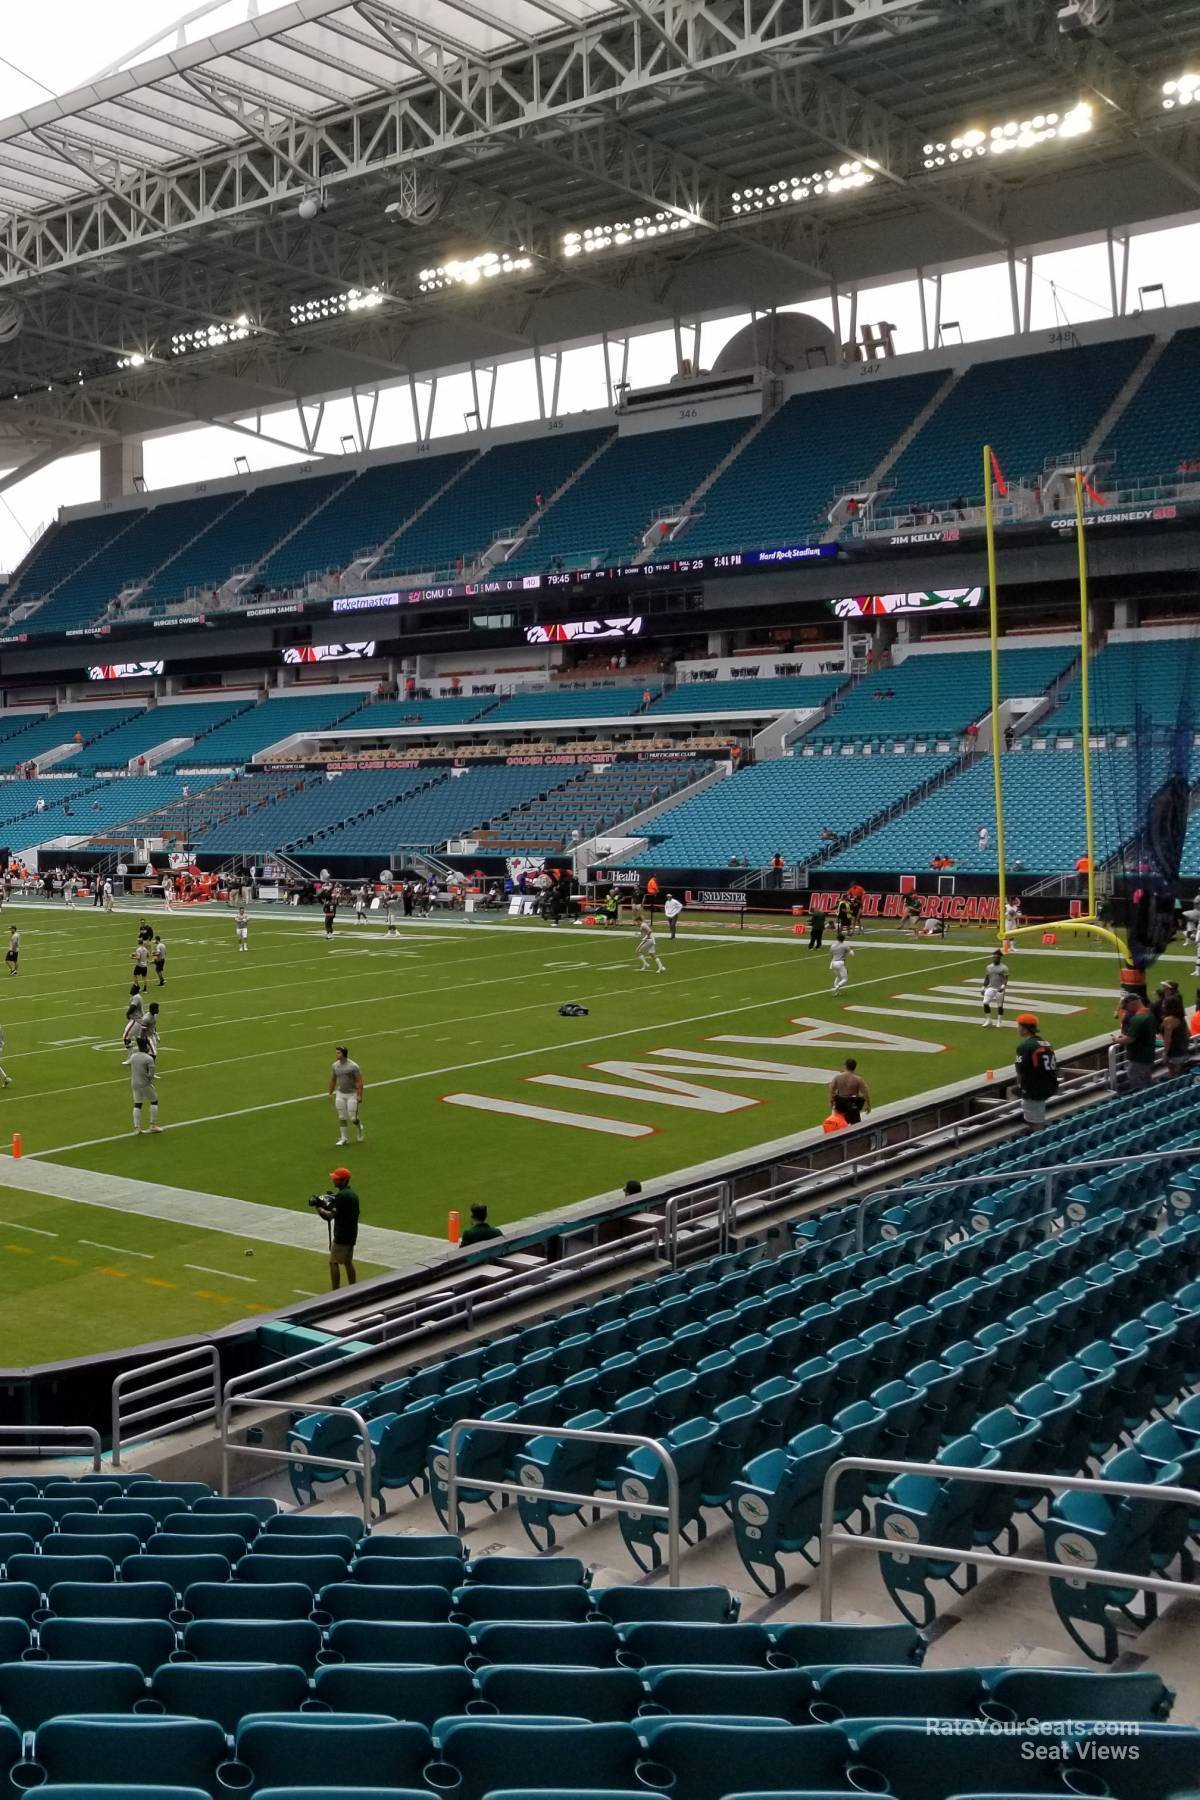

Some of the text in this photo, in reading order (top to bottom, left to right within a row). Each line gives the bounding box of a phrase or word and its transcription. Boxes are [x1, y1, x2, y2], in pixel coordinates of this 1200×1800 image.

[1097, 510, 1152, 524] KENNEDY
[890, 535, 909, 545] JIM
[910, 532, 942, 543] KELLY
[484, 584, 500, 592] MIA
[547, 576, 570, 585] 79:45
[425, 589, 444, 600] CMU
